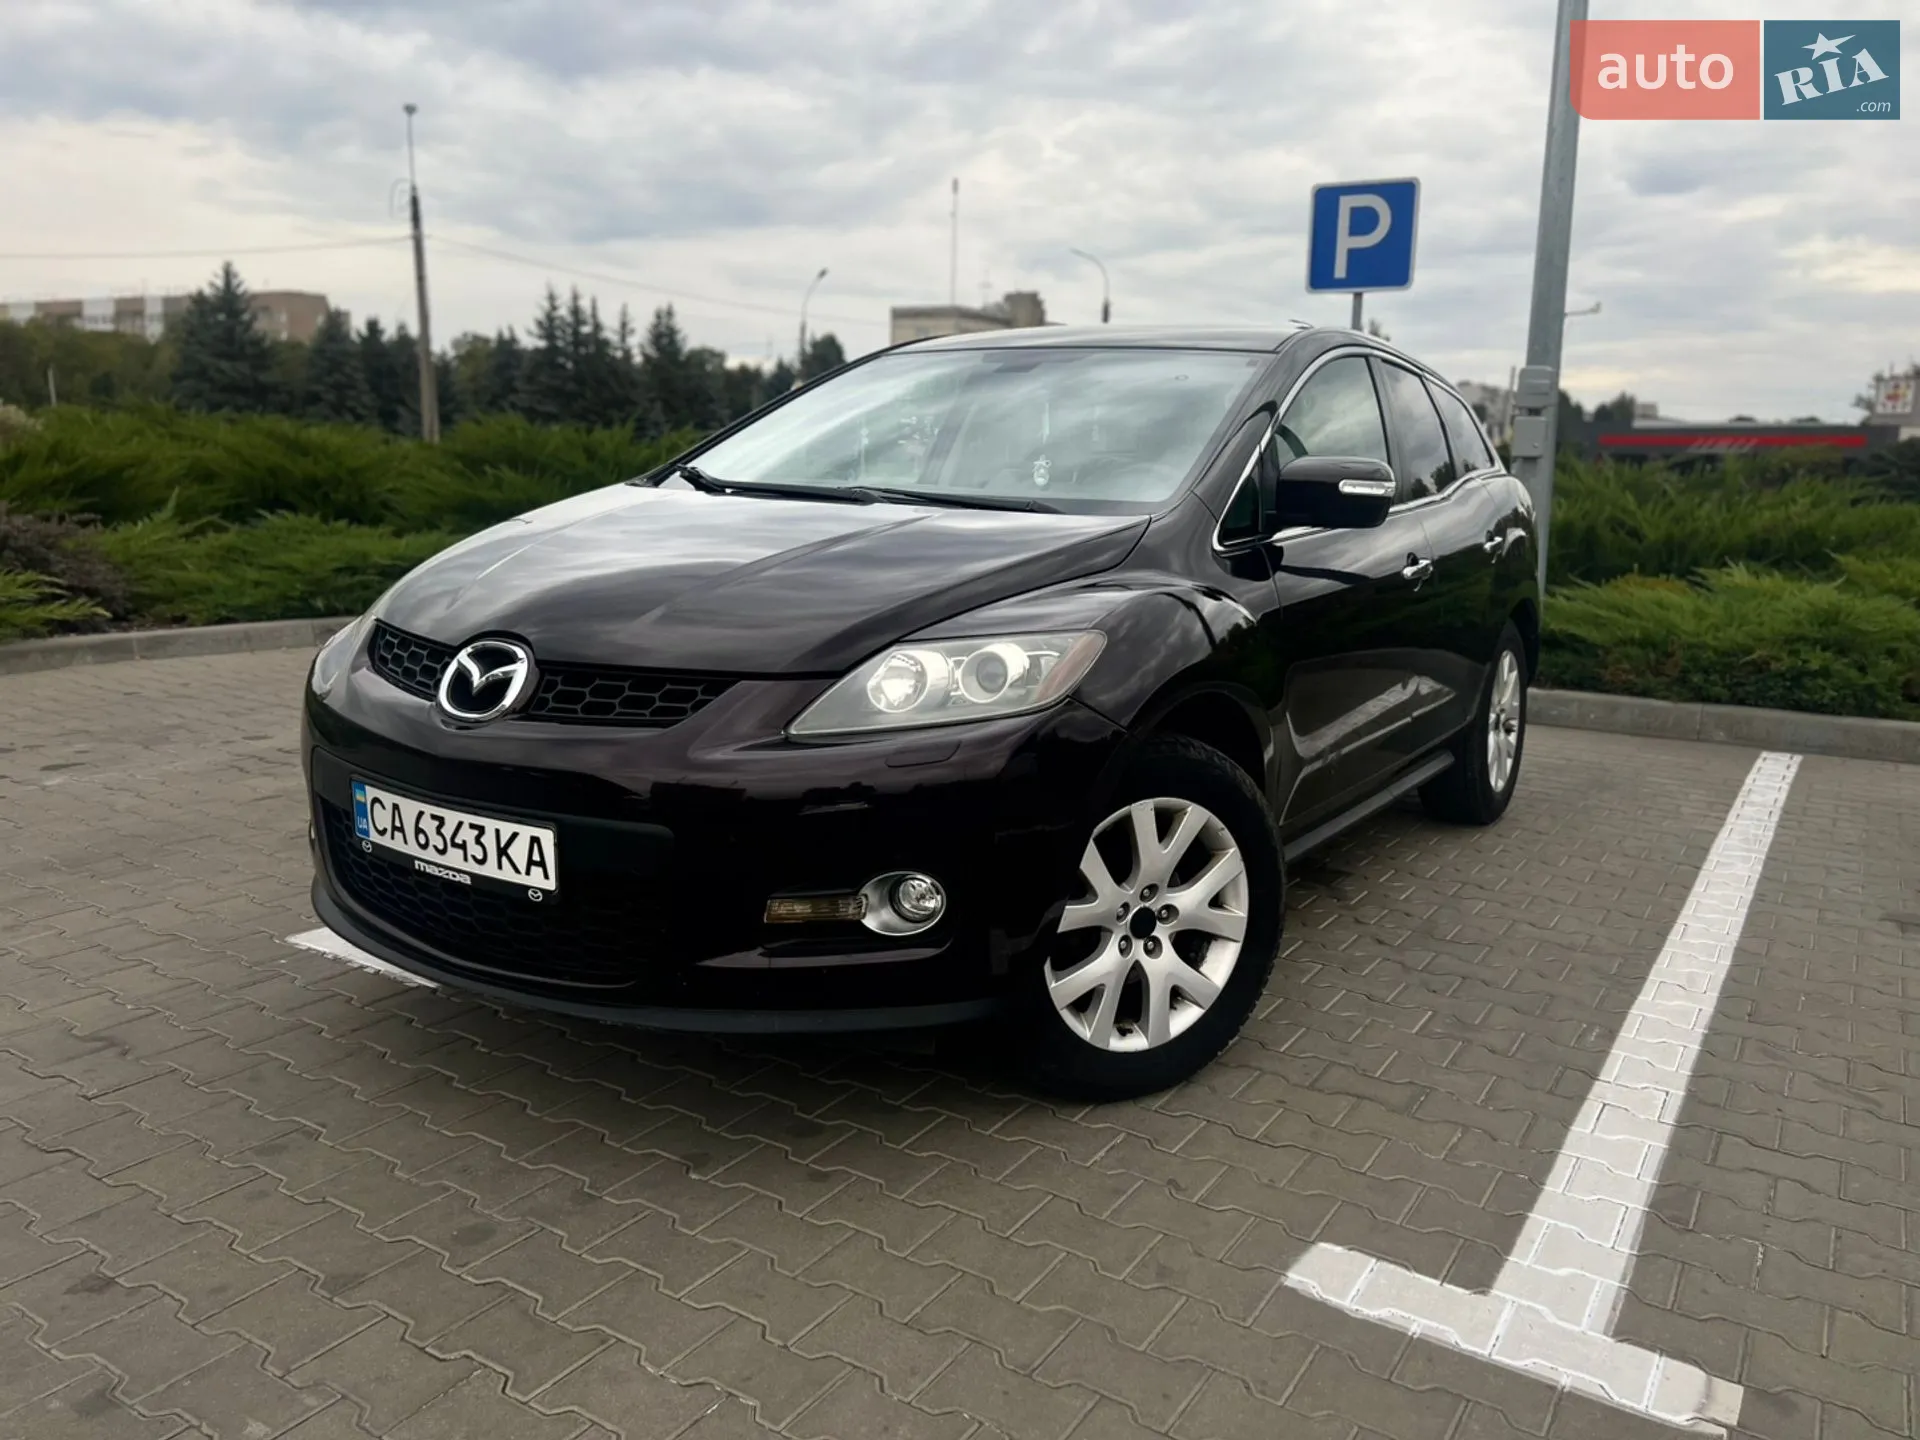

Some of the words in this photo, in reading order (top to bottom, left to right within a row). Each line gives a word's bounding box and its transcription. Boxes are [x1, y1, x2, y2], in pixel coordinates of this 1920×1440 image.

[1334, 193, 1392, 279] P
[357, 815, 368, 831] UA
[370, 797, 408, 845] CA
[414, 810, 488, 867] 6343
[494, 827, 550, 881] KA
[414, 860, 471, 885] mazda
